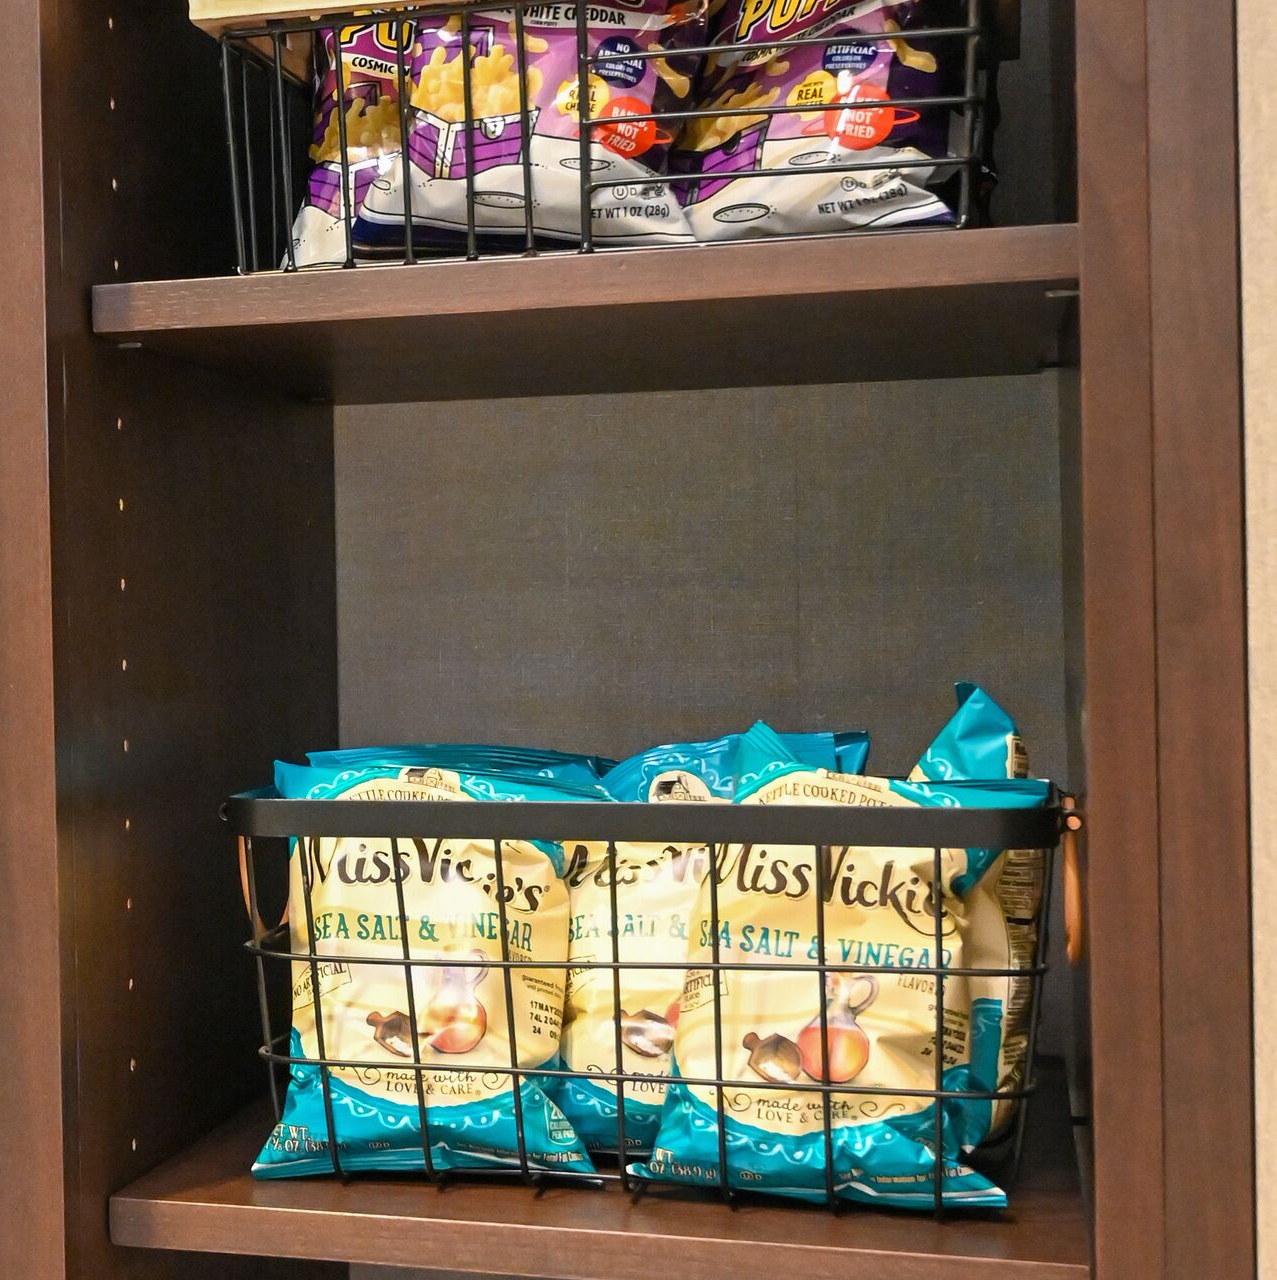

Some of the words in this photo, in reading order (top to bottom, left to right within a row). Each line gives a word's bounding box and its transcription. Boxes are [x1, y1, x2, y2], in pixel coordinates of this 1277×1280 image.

[564, 6, 626, 26] CHEDDAR
[616, 43, 631, 53] NO
[826, 45, 875, 56] ARTIFICIAL
[352, 56, 396, 75] COSMIC
[796, 87, 823, 101] REAL
[617, 122, 639, 140] NOT
[608, 134, 636, 152] FRIED
[606, 204, 621, 219] WT
[630, 204, 642, 218] OZ
[644, 201, 670, 220] (28g)
[818, 202, 836, 215] NET
[803, 783, 856, 806] COOKED
[314, 913, 349, 943] SEA
[357, 914, 410, 941] SALT
[419, 915, 439, 942] &
[739, 924, 800, 958] SALT
[532, 1025, 542, 1035] 24
[433, 1070, 477, 1084] with
[425, 1082, 436, 1096] &
[440, 1083, 474, 1096] CARE
[756, 1097, 799, 1112] made
[757, 1108, 794, 1123] LOVE
[798, 1110, 808, 1123] &
